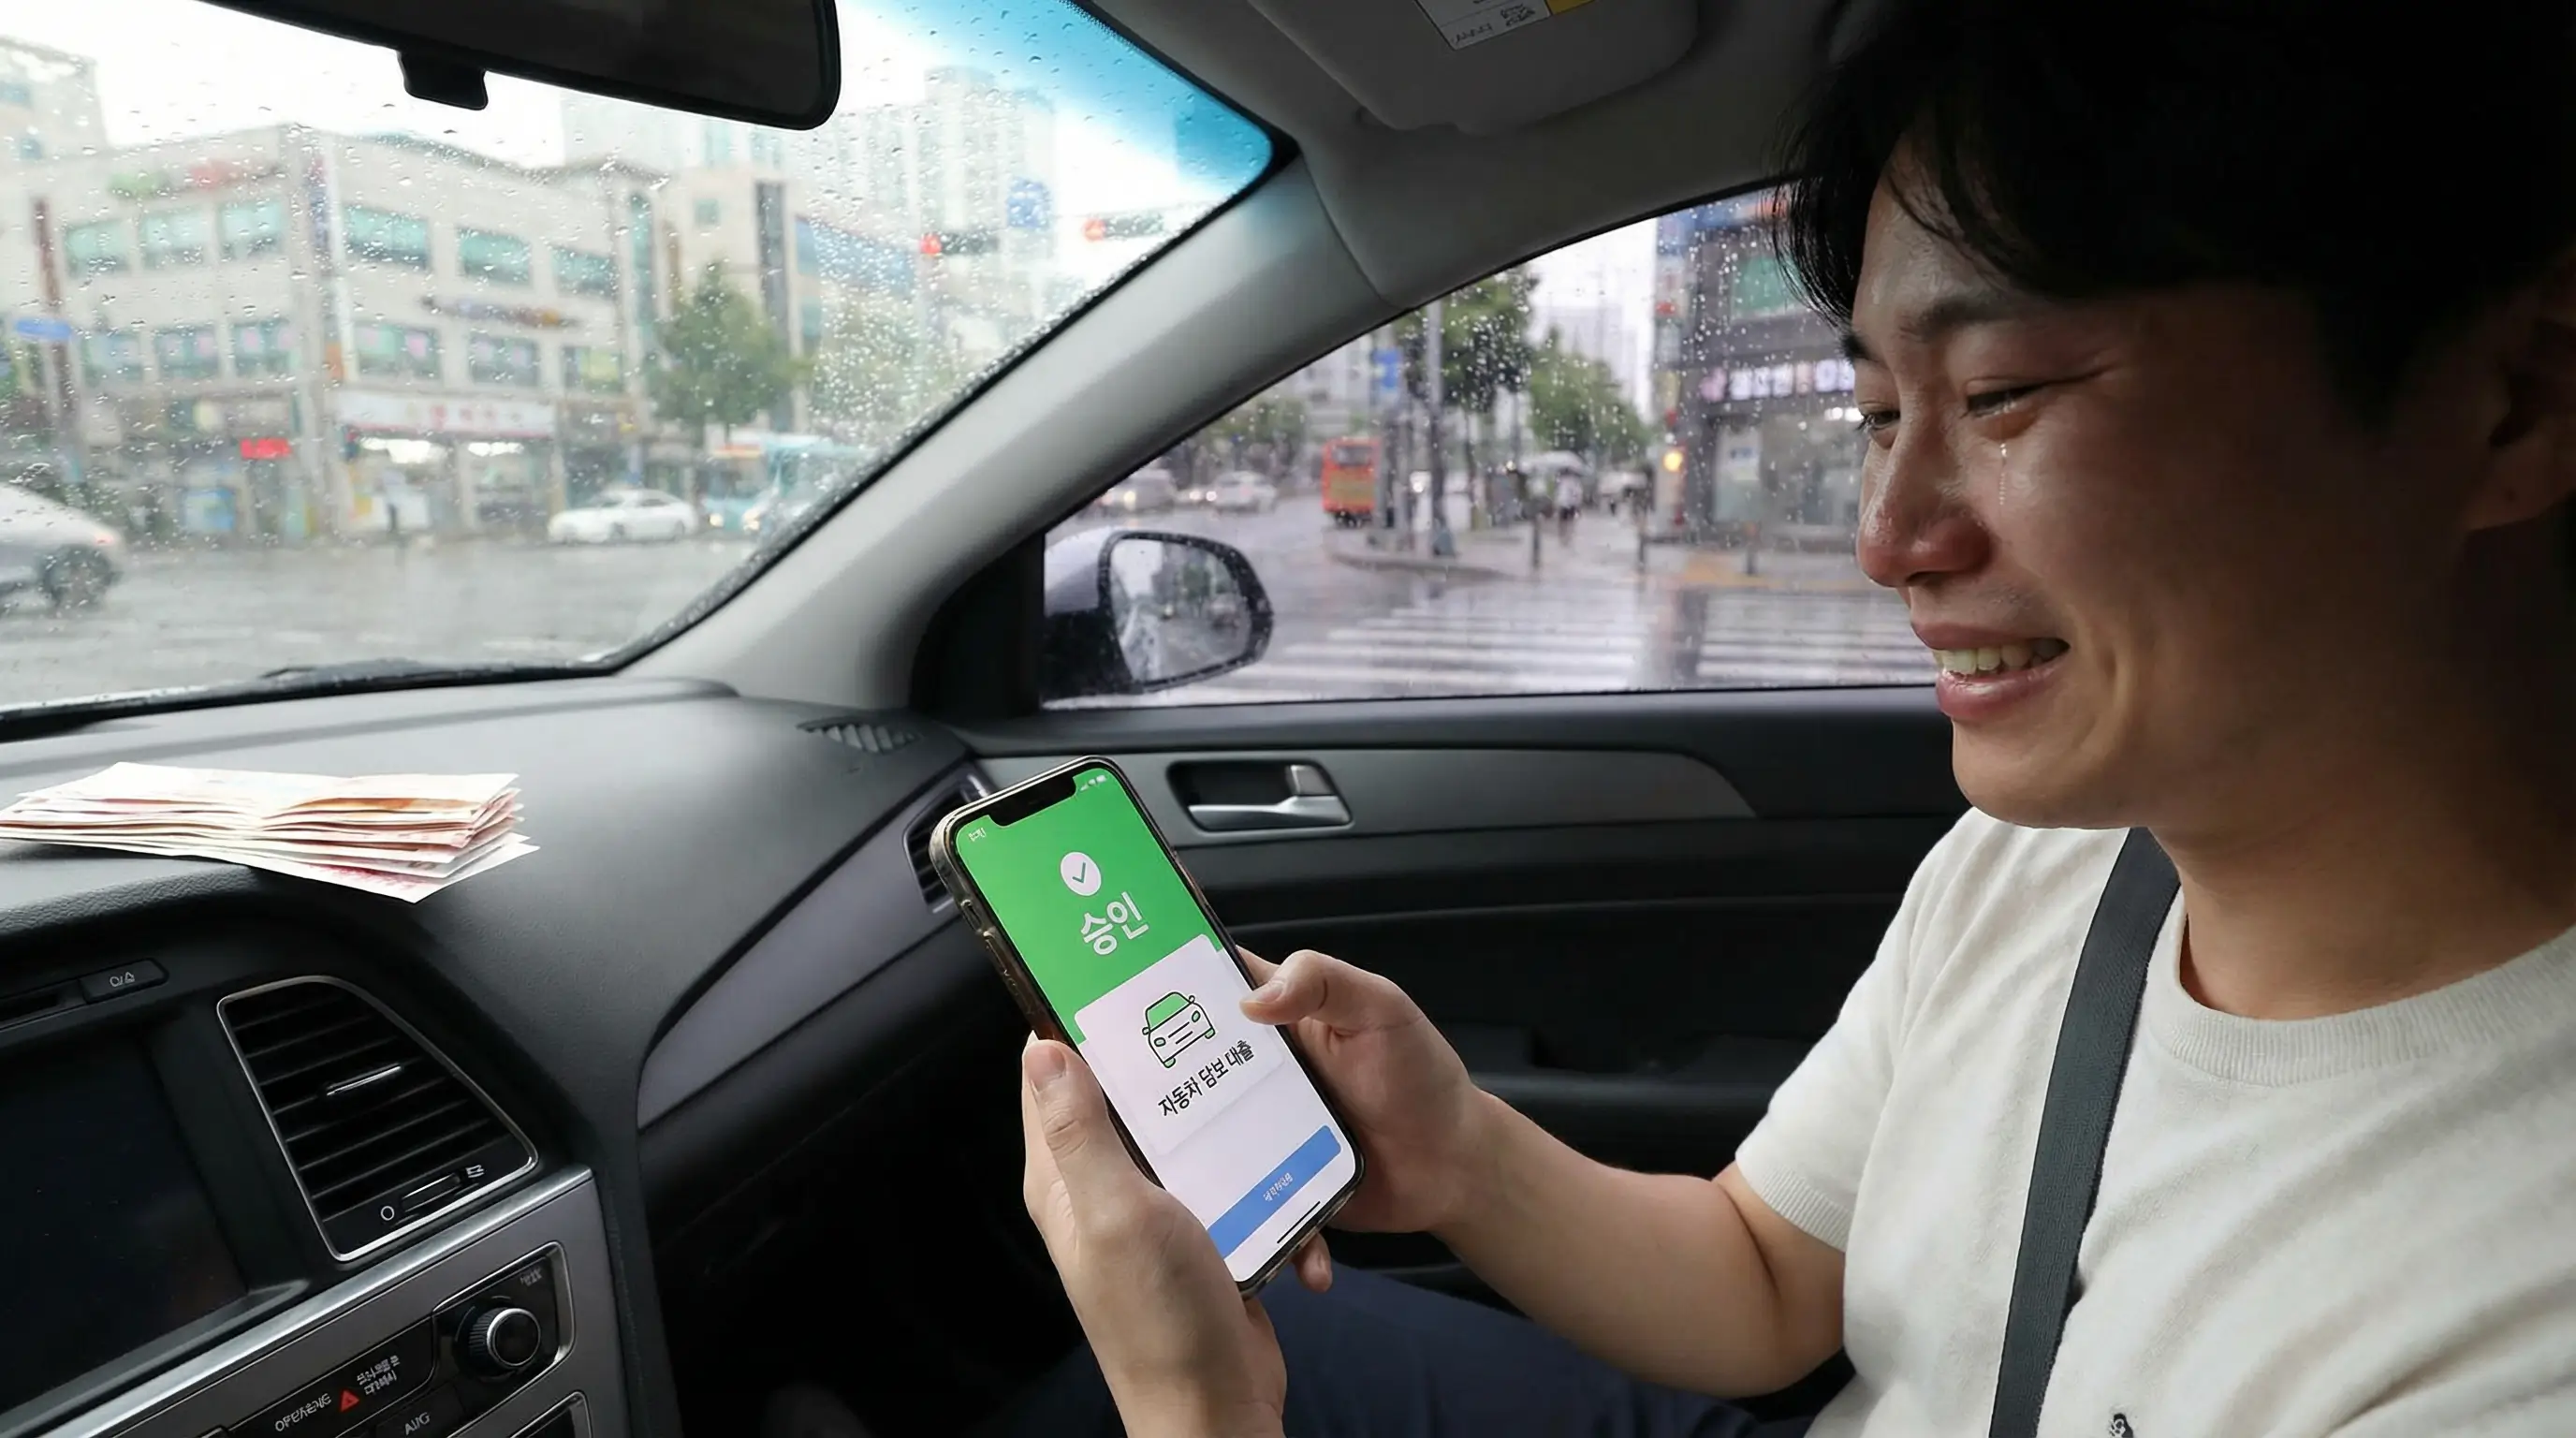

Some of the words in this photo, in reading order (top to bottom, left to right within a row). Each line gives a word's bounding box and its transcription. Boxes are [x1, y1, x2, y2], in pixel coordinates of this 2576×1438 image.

[1080, 890, 1149, 955] 승인
[1157, 1076, 1203, 1116] 자동차
[1197, 1057, 1229, 1088] 담보
[1223, 1039, 1254, 1066] 대출
